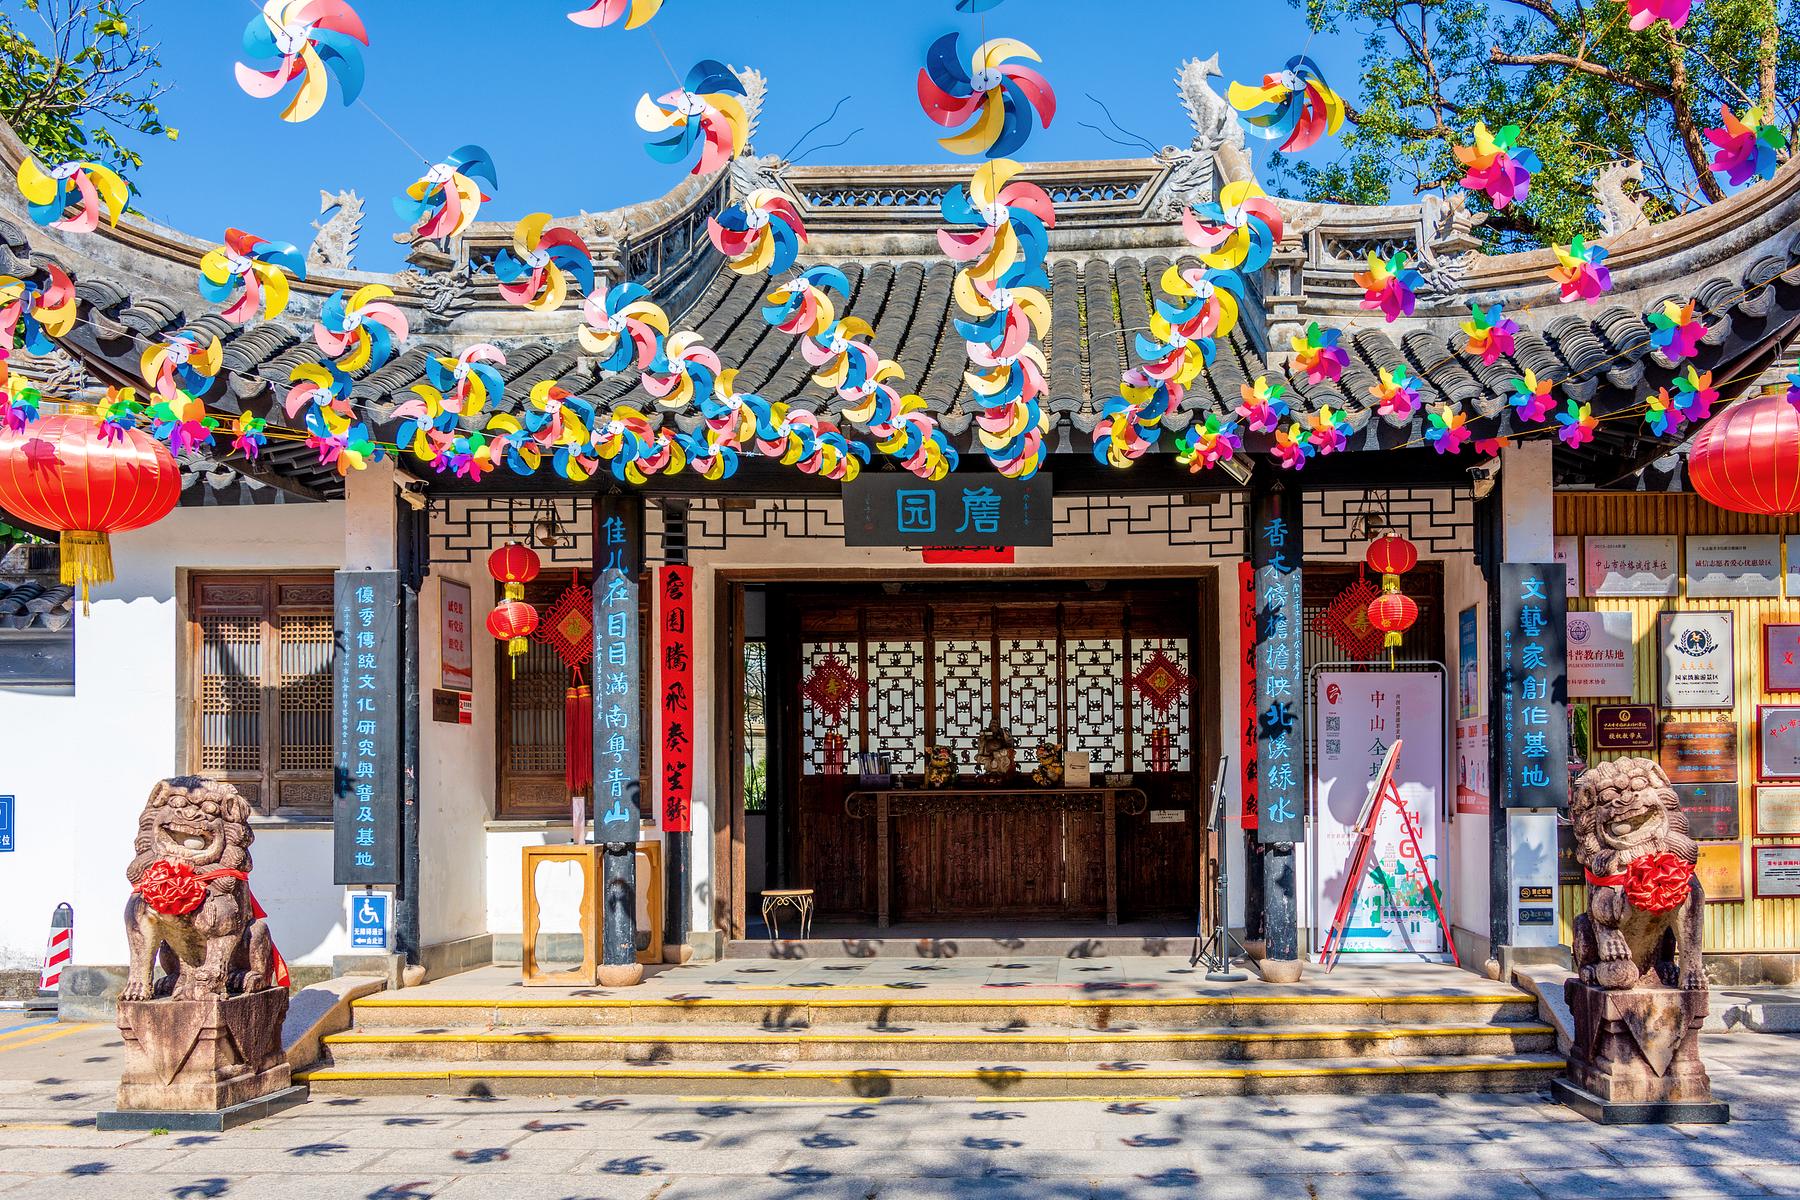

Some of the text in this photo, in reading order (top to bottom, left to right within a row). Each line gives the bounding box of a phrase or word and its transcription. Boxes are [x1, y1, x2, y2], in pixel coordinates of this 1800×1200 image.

[1596, 560, 1668, 572] 中山市价格诚信单位
[1770, 719, 1800, 738] 中山市
